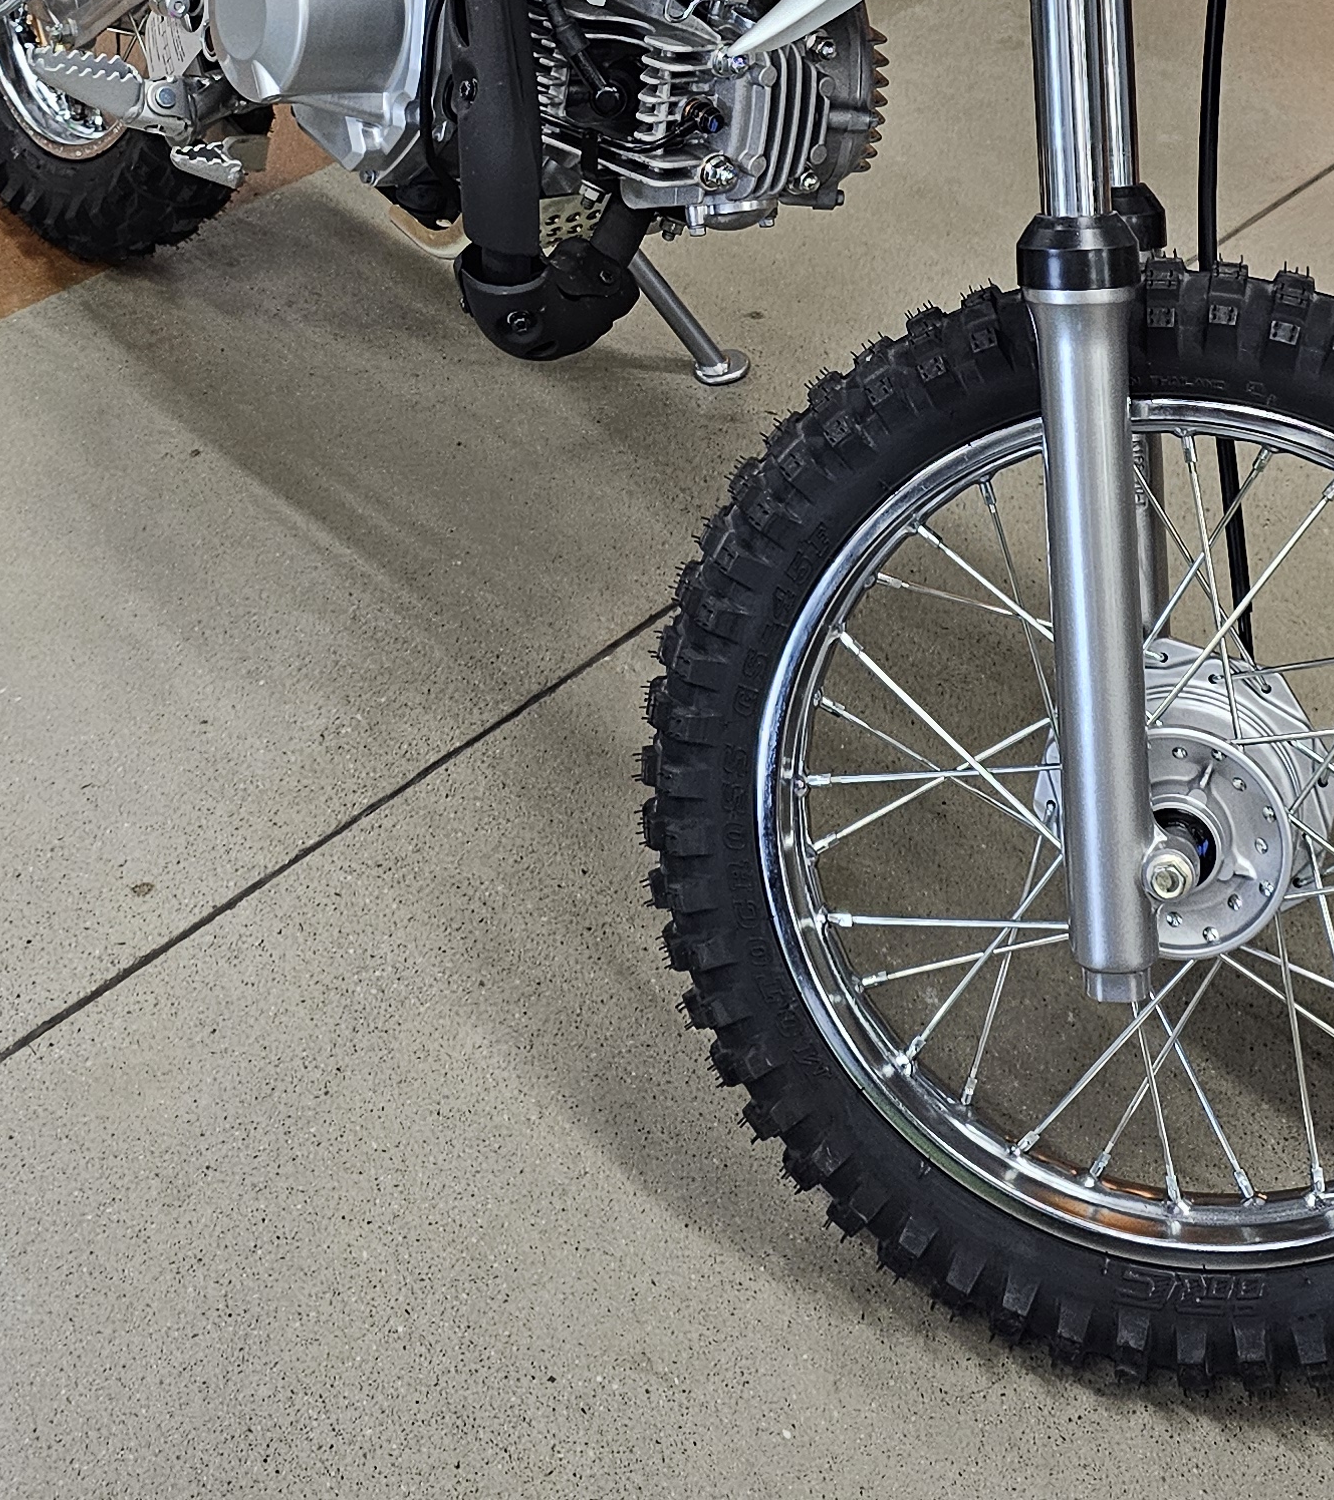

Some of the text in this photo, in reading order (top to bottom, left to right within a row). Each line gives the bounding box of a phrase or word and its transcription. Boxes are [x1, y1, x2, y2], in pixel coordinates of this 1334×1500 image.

[1148, 374, 1227, 391] THAILAND
[732, 521, 832, 718] GS-45F
[721, 742, 835, 1081] MOTOCROSS
